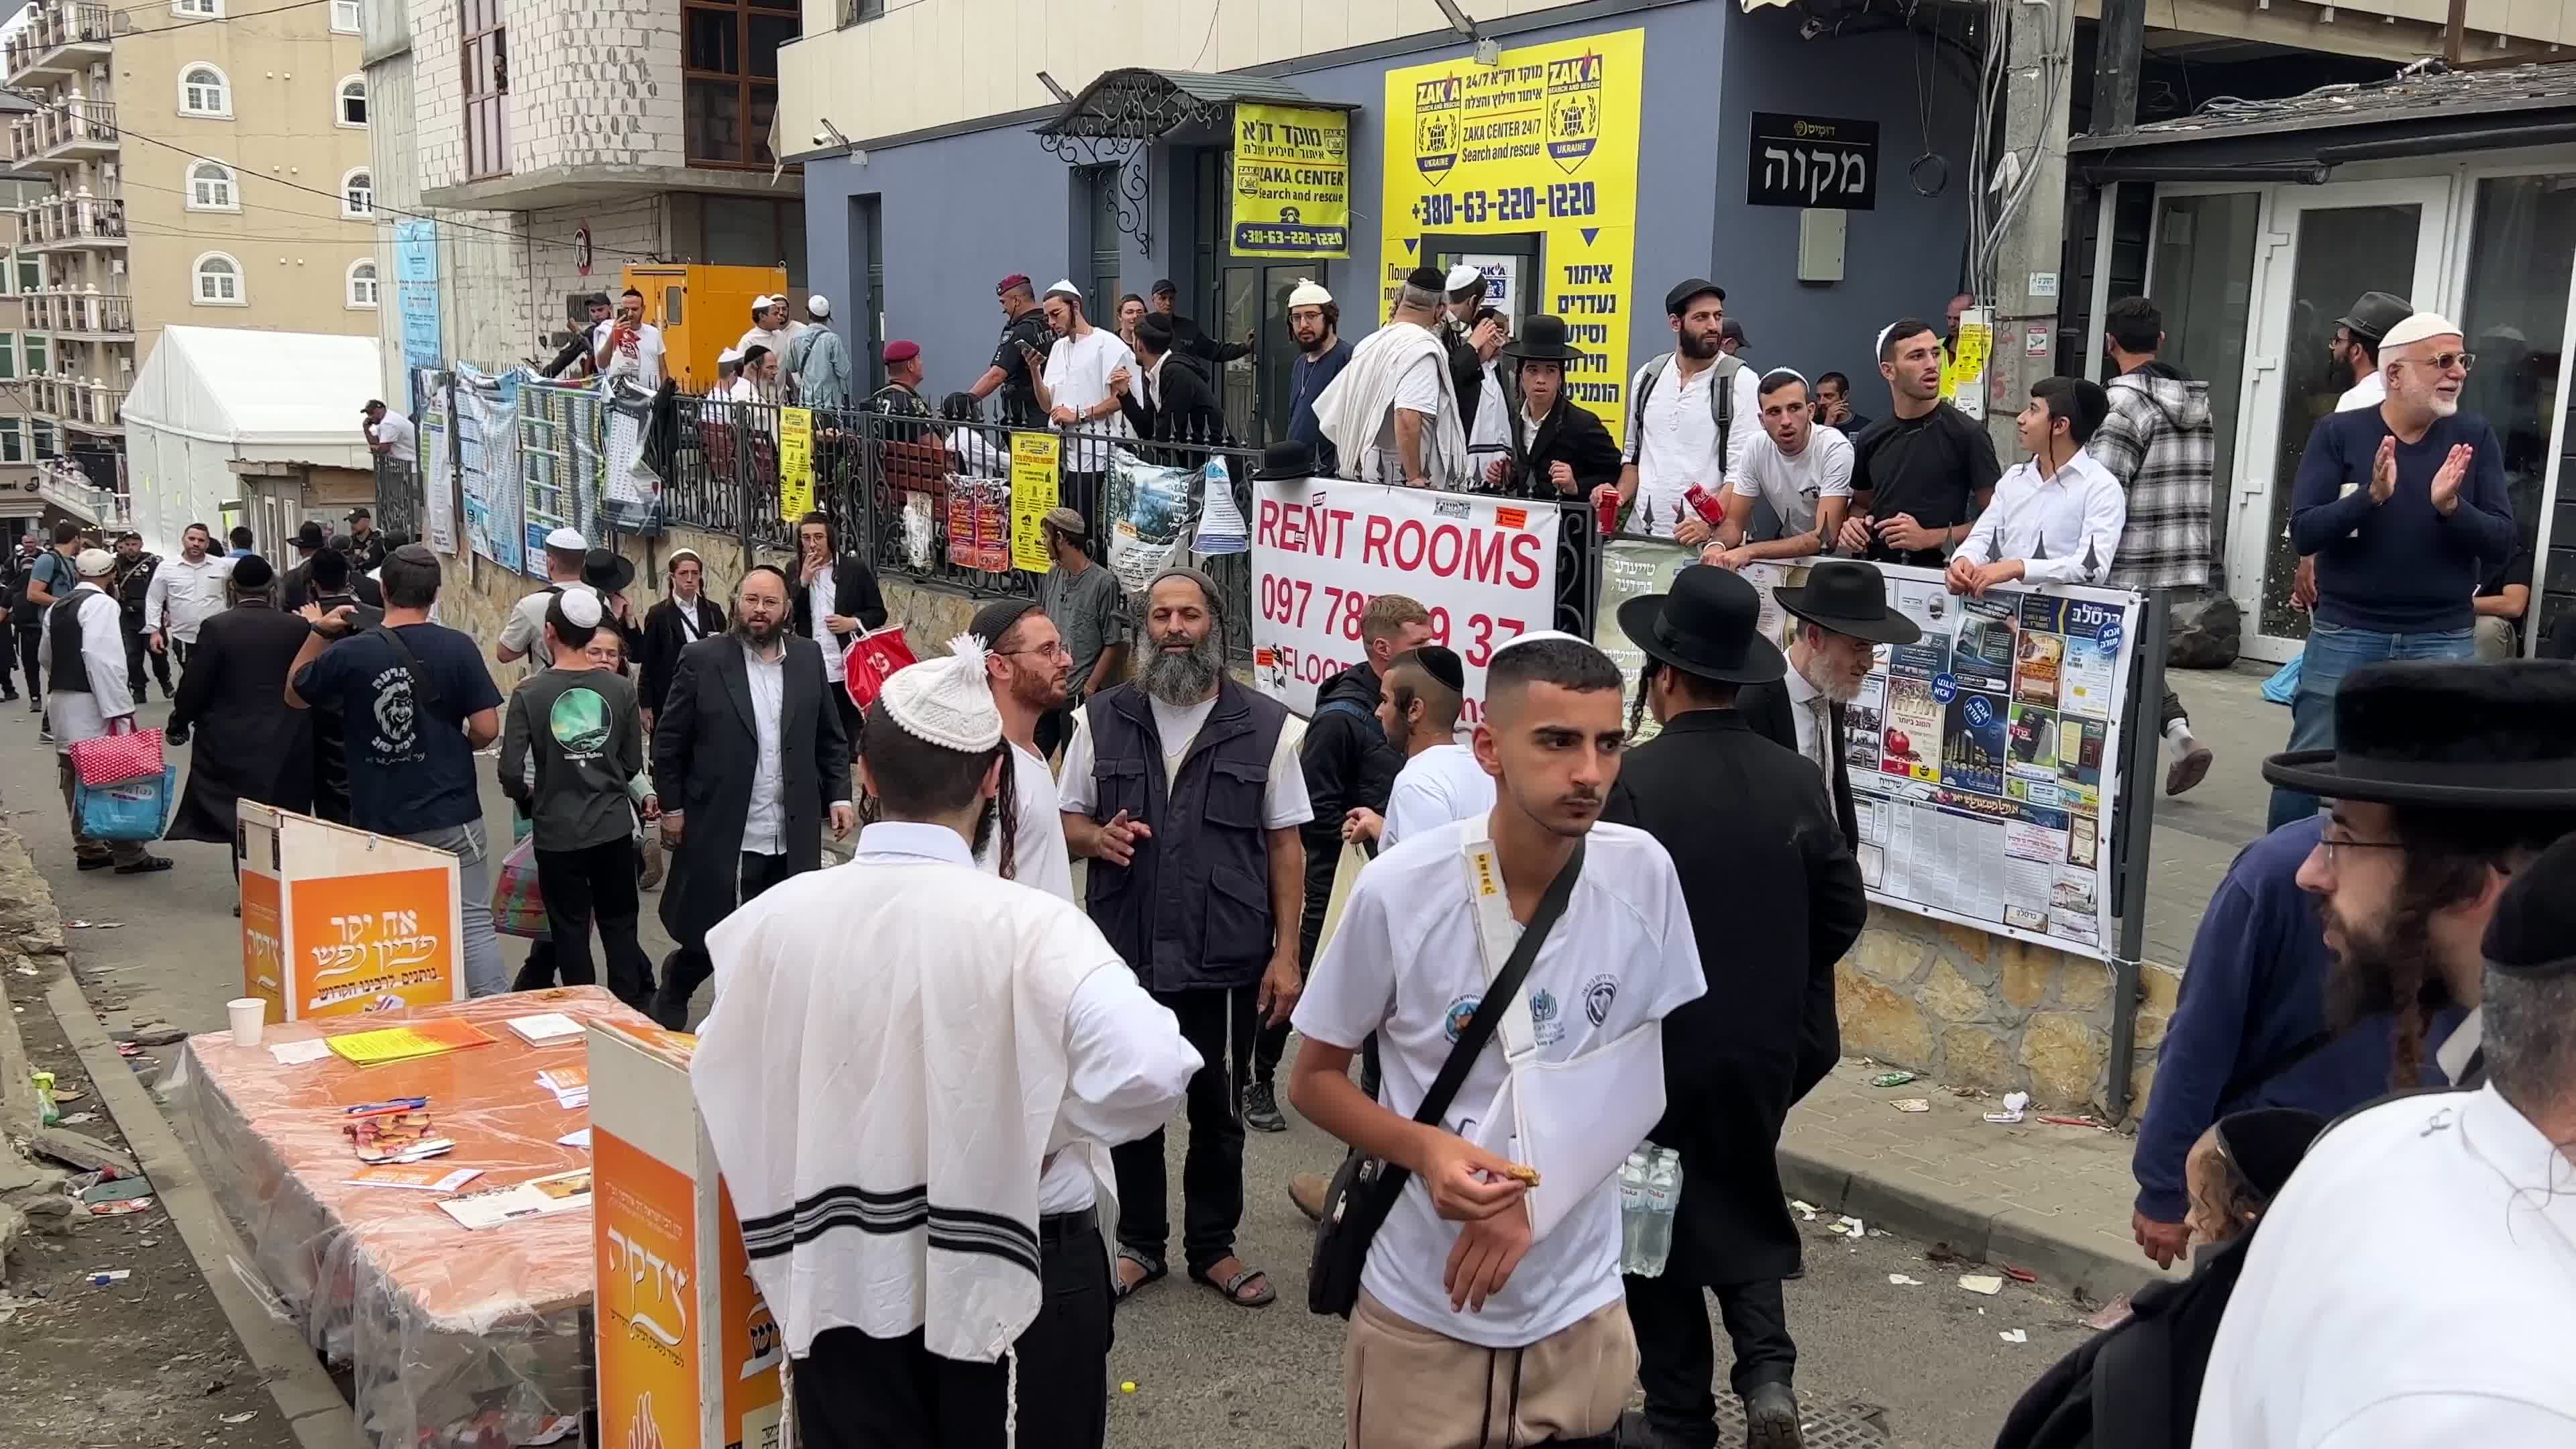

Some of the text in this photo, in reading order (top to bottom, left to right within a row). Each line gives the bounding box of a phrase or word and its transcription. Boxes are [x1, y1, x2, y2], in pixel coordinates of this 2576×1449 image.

[1466, 74, 1489, 89] 24/7
[1518, 65, 1543, 81] מוקד
[1491, 91, 1515, 109] חילוץ
[1517, 88, 1542, 102] איתור
[1279, 124, 1322, 148] מוקד
[1463, 118, 1542, 142] ZAKA CENTER 24/7
[1268, 145, 1294, 157] חילוץ
[1299, 148, 1326, 160] איתור
[1462, 142, 1540, 163] Search and rescue
[1556, 142, 1587, 154] UKRAINE
[1424, 156, 1449, 168] UKRAINE
[1259, 167, 1344, 186] ZAKA CENTER
[1765, 146, 1866, 205] מקוה
[1259, 188, 1343, 202] Search and rescue
[1412, 181, 1595, 225] +380-63-220-1220
[1564, 264, 1613, 285] איתור
[1557, 294, 1617, 314] נעדרים
[1564, 382, 1619, 402] הומניט
[1258, 498, 1354, 559] RENT
[1363, 515, 1542, 590] ROOMS
[1261, 574, 1313, 628] 097
[1324, 586, 1375, 641] 78
[331, 909, 419, 943] אח יקר
[372, 934, 437, 973] פדיון
[317, 967, 437, 1000] נותנים לרבינו הקדוש
[607, 1224, 688, 1347] צדקה
